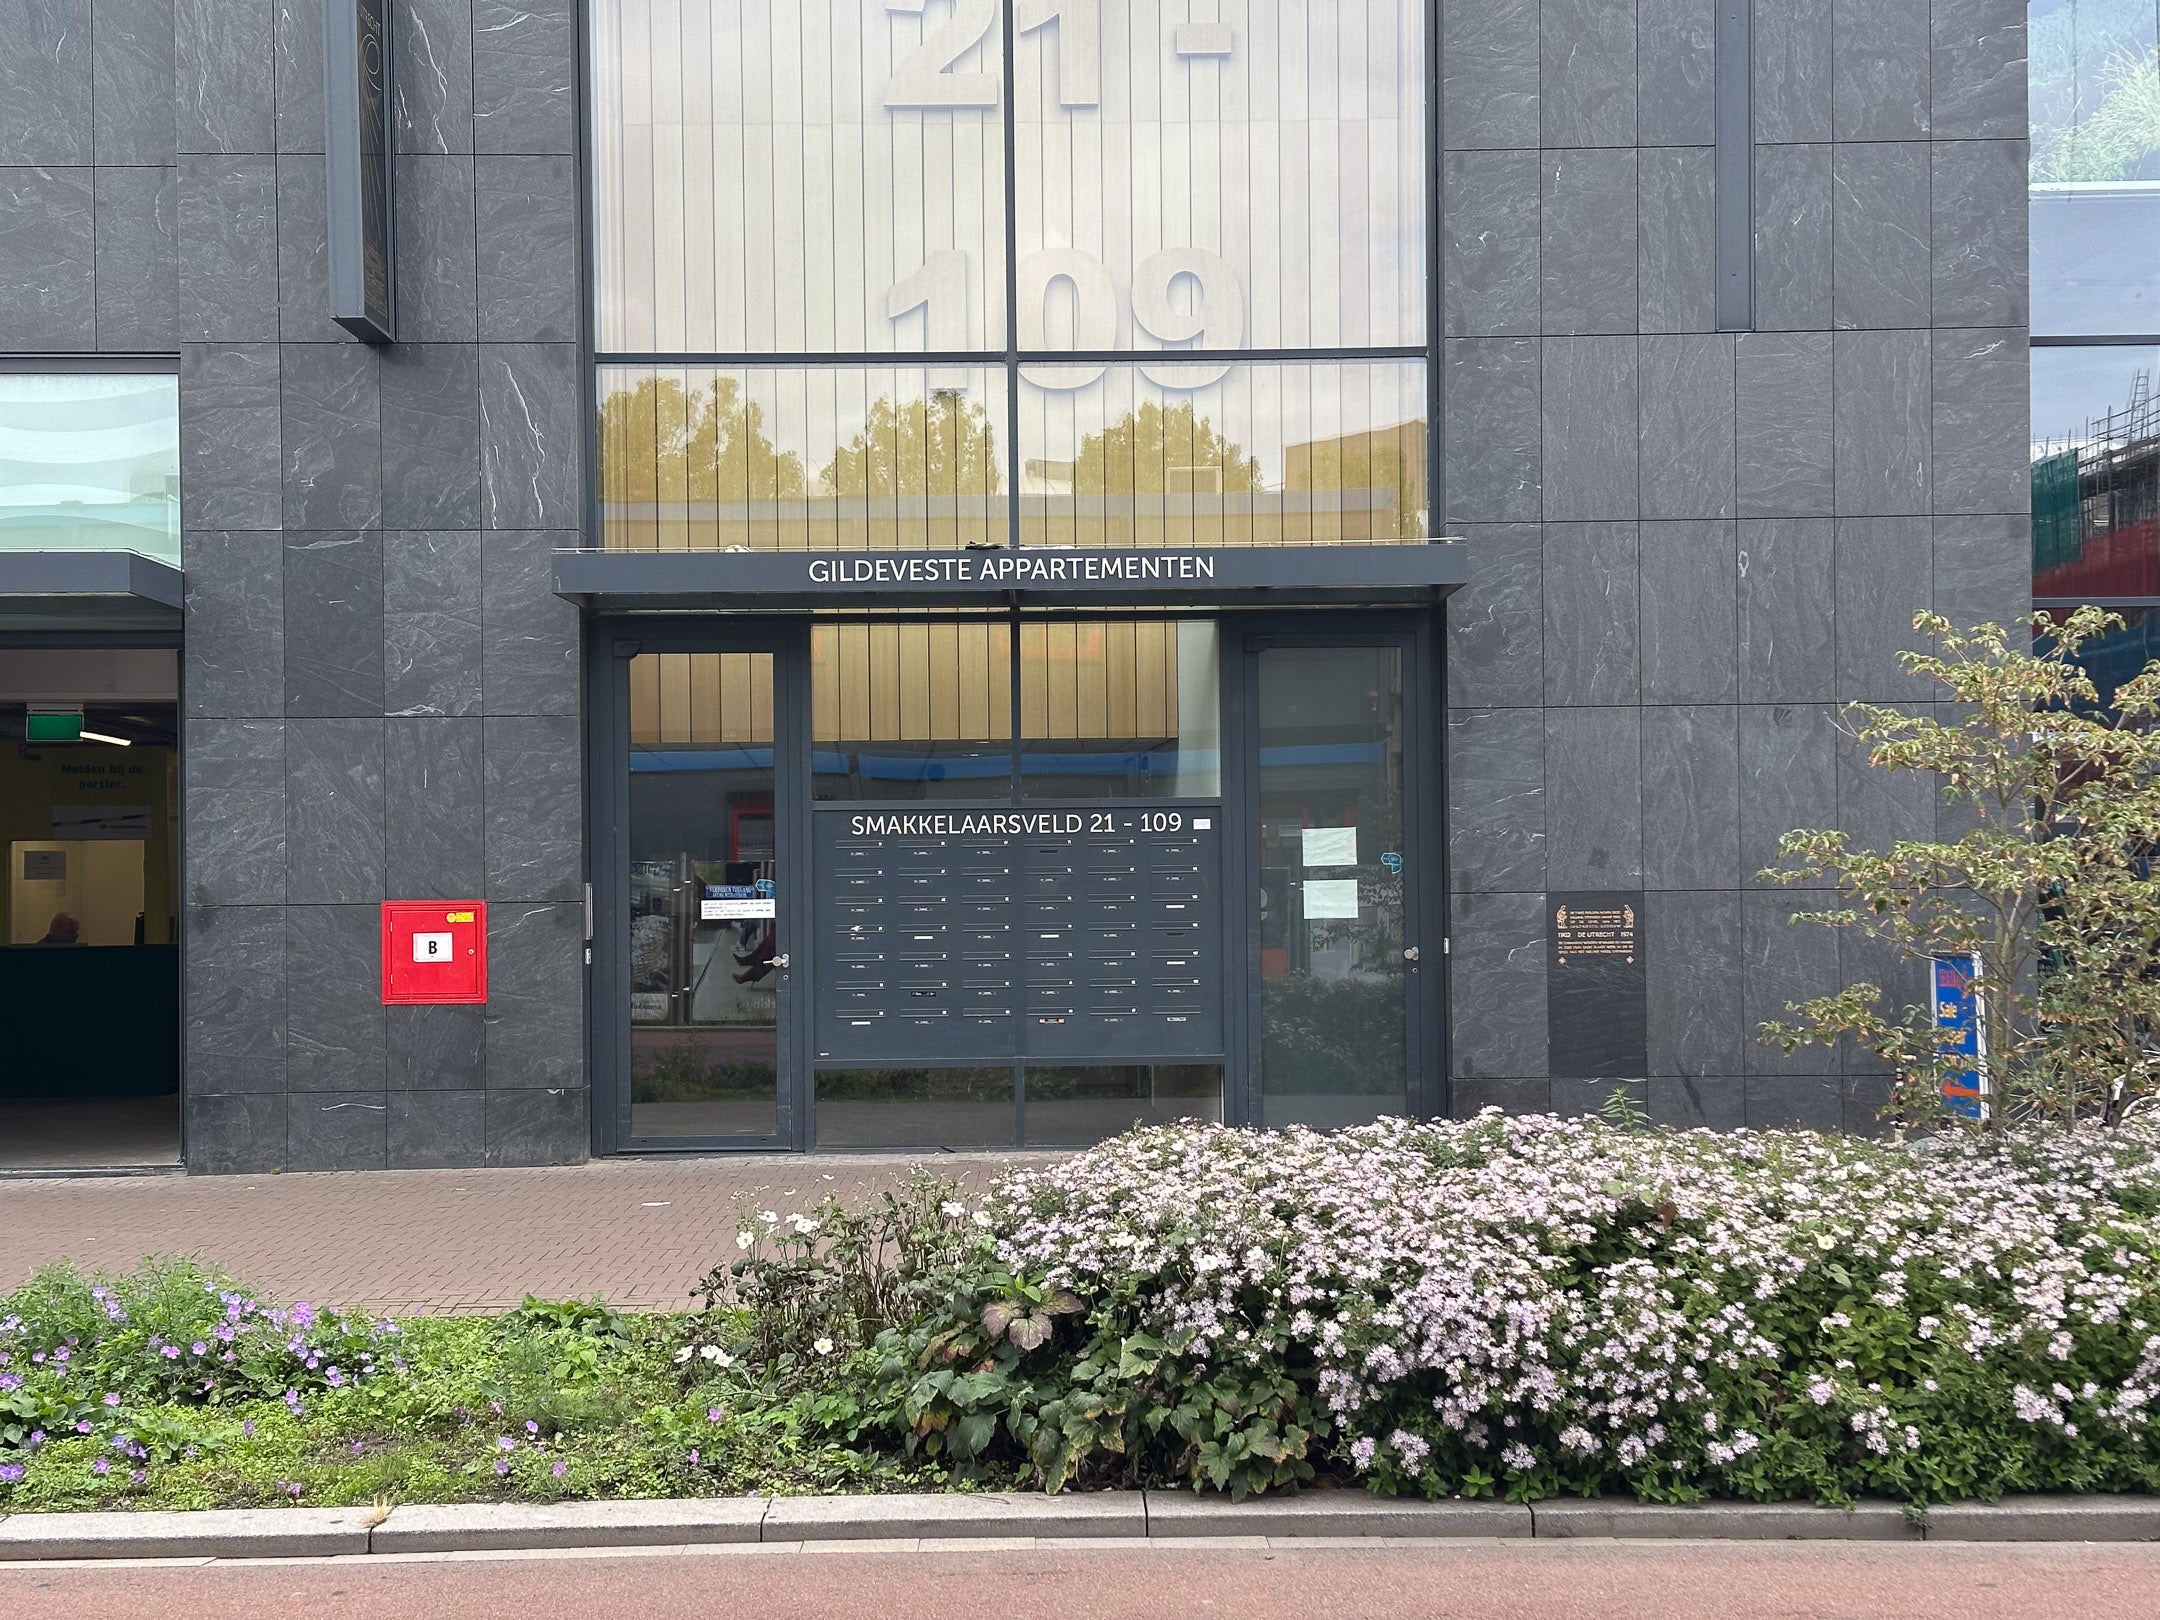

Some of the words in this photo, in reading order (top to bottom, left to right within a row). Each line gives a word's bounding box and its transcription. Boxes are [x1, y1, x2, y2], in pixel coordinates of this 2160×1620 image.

[883, 0, 1100, 107] 21
[887, 247, 1244, 390] 109
[808, 558, 972, 583] GILDEVESTE
[979, 556, 1214, 581] APPARTEMENTEN
[128, 764, 144, 774] de
[850, 813, 1083, 836] SMAKKELAARSVELD
[1089, 813, 1116, 833] 21
[1140, 812, 1182, 833] 109
[428, 941, 438, 955] B
